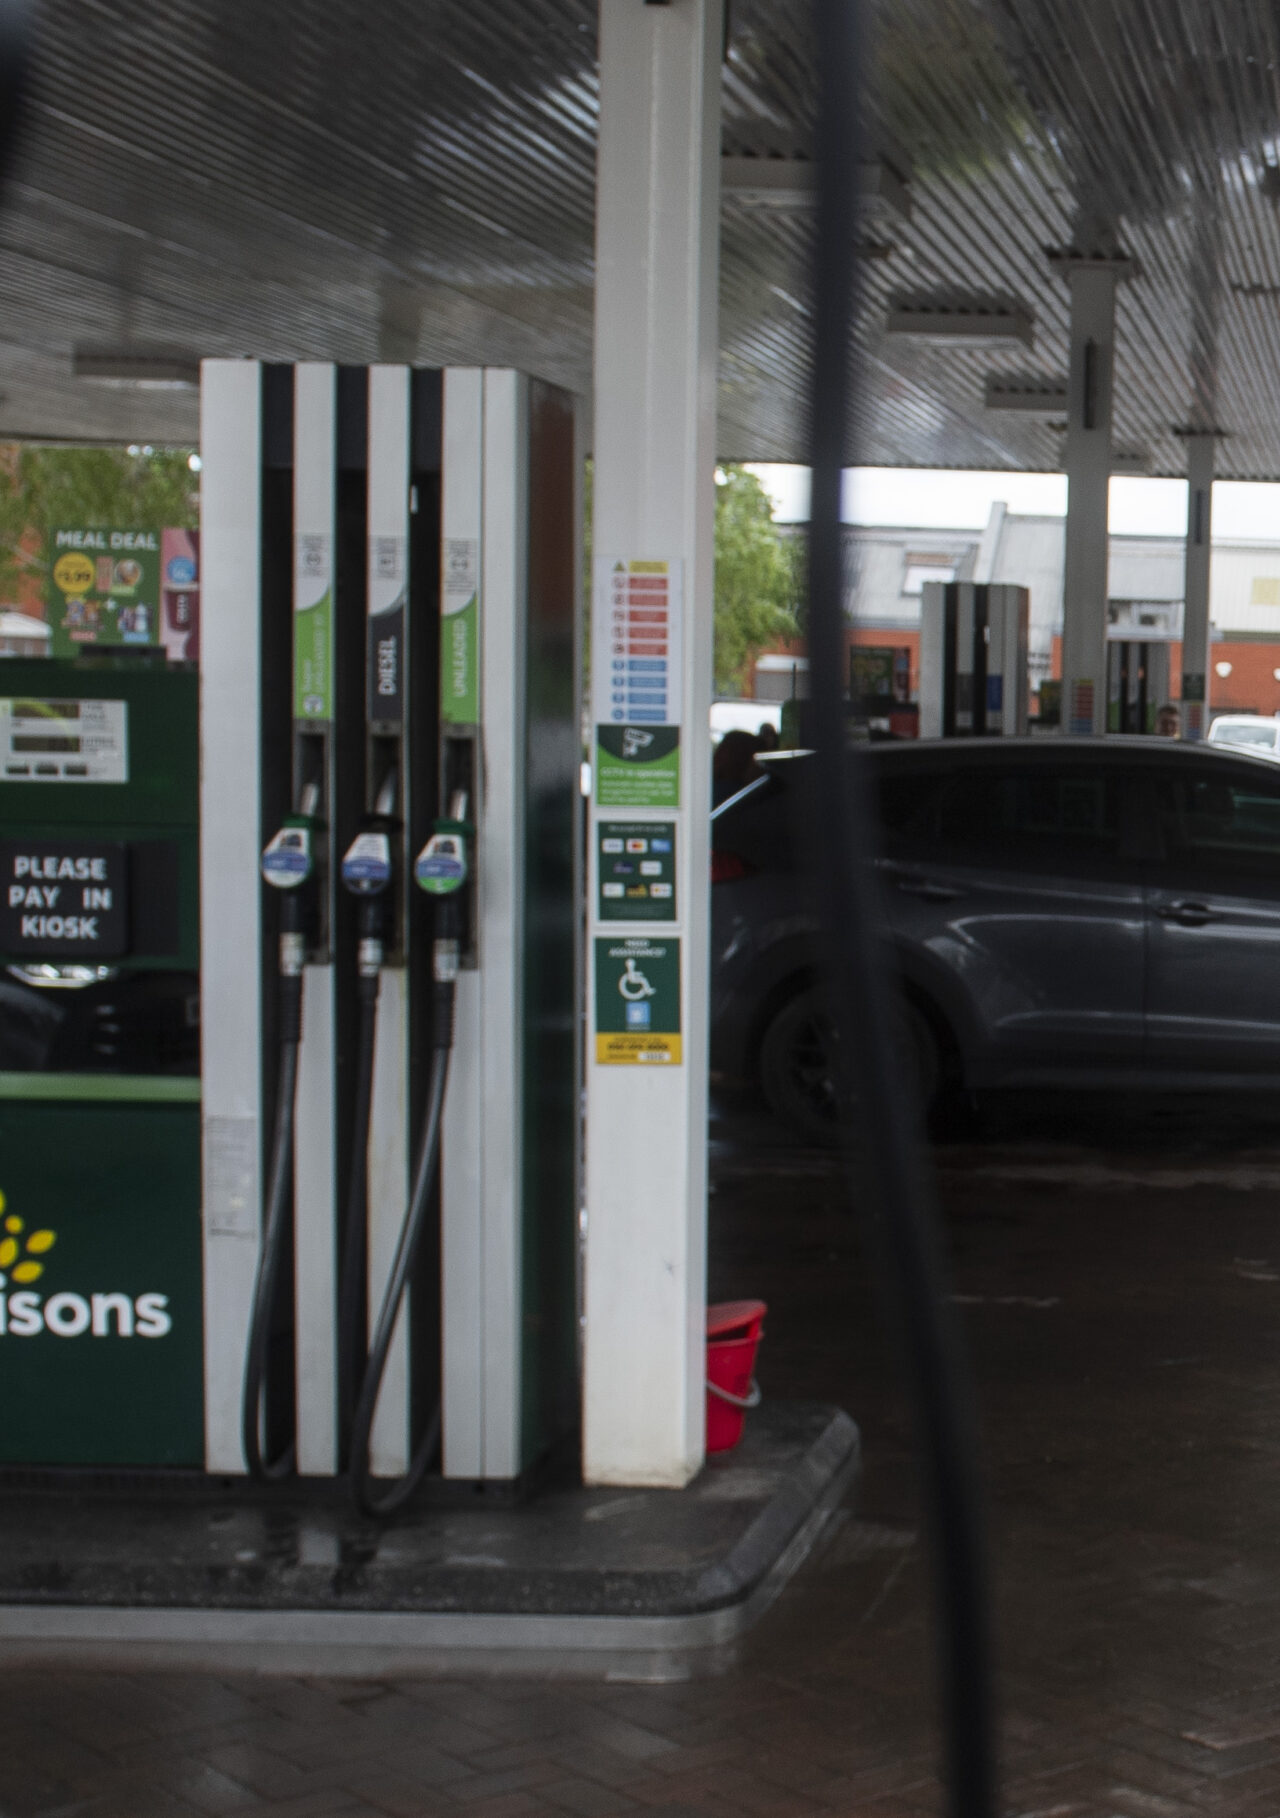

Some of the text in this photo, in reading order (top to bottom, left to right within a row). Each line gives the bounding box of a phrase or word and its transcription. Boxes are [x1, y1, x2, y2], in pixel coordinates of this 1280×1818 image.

[56, 530, 158, 551] MEAL DEAL
[379, 635, 397, 696] DIESEL
[453, 618, 467, 698] UNLEADED
[14, 855, 107, 881] PLEASE
[8, 884, 112, 911] PAY IN
[21, 914, 99, 940] KIOSK
